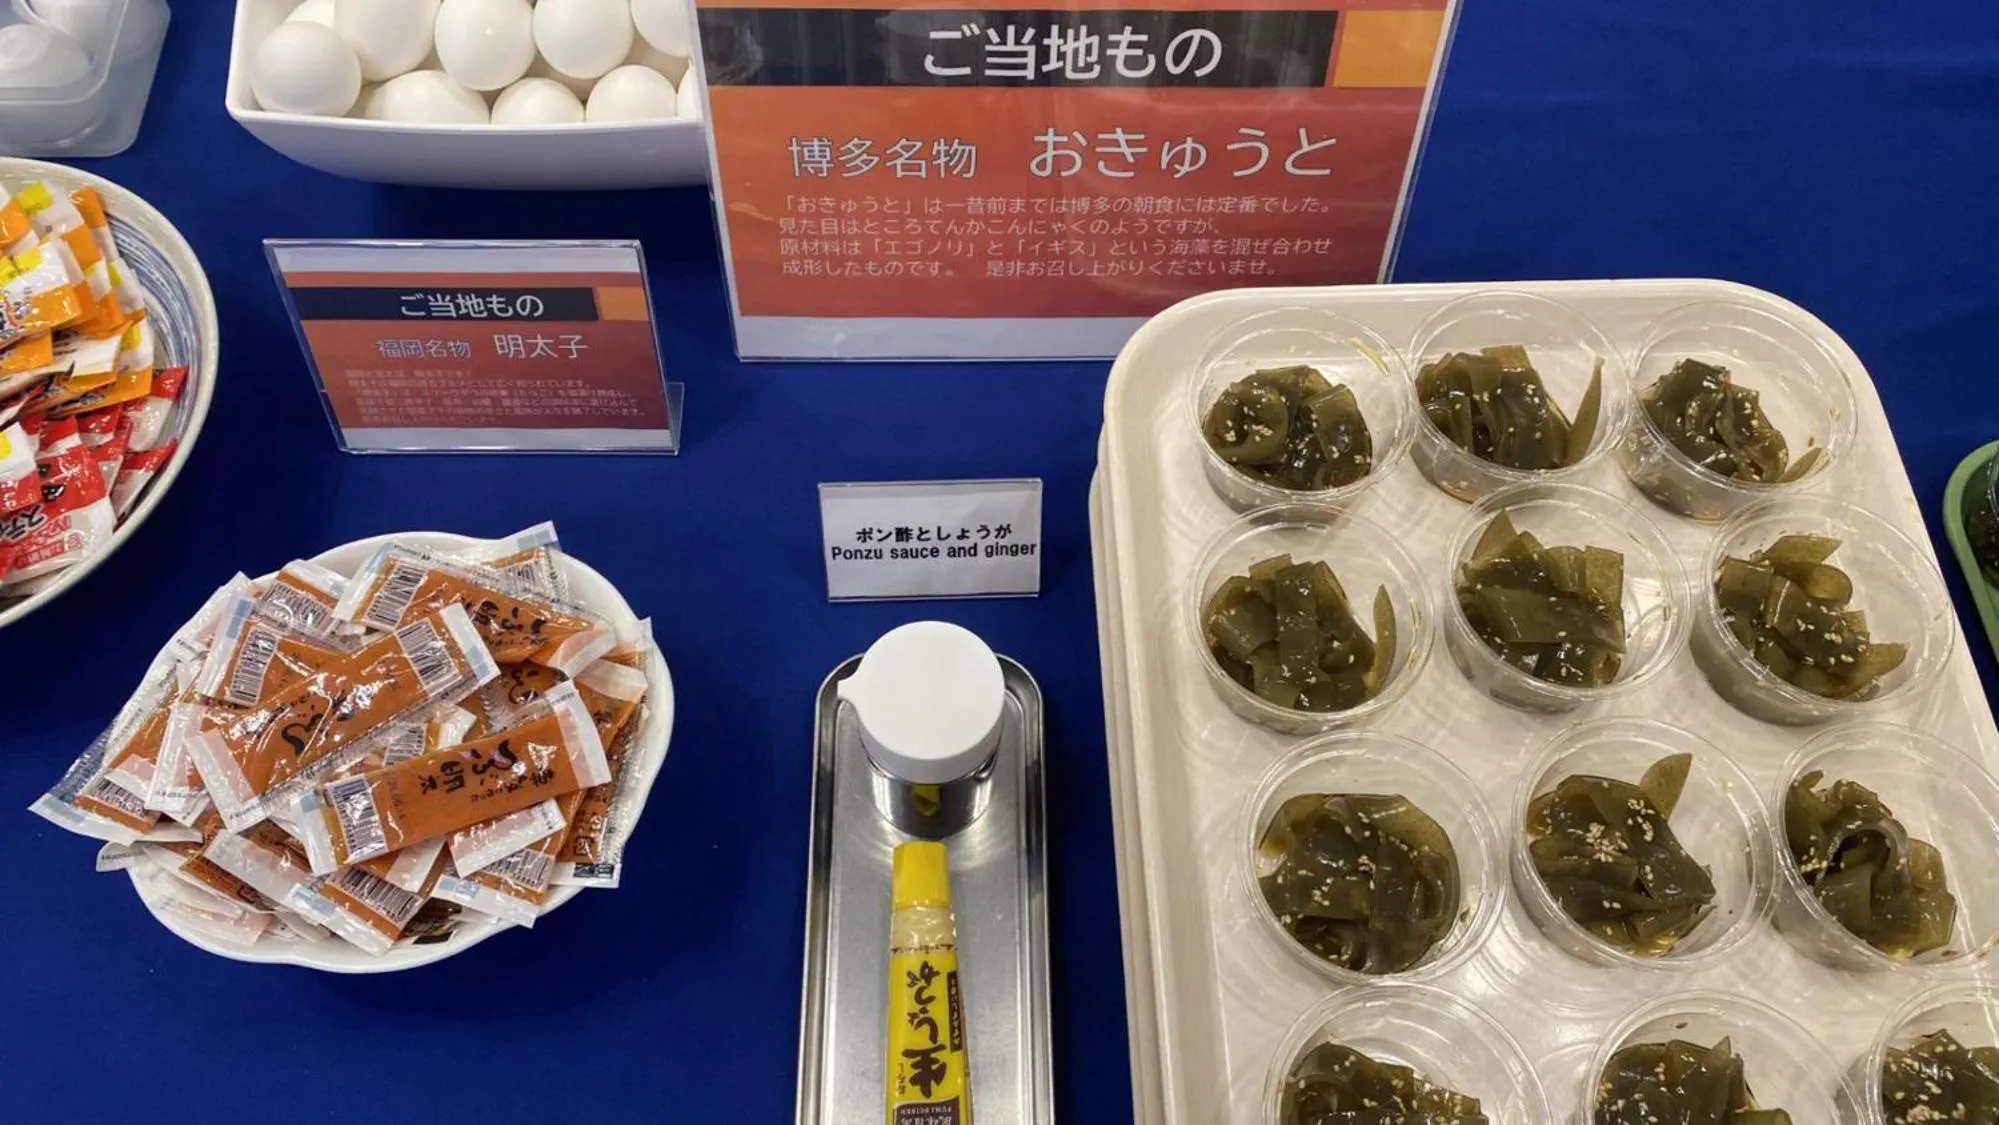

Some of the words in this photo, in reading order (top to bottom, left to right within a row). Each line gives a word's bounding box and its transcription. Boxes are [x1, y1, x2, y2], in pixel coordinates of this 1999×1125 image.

[922, 23, 1222, 80] ご当地もの
[788, 138, 977, 179] 博多名物
[1029, 126, 1335, 179] おきゅうと
[784, 194, 1330, 215] 「おきゅうと」は一昔前までは博多の朝食には定番でした。
[399, 292, 543, 318] ご当地もの
[376, 339, 472, 359] 福岡名物
[493, 333, 589, 360] 明太子
[832, 545, 883, 560] Ponzu
[890, 546, 940, 559] sauce
[947, 543, 978, 557] and
[984, 541, 1037, 559] ginger
[902, 960, 947, 1098] 生しょうが
